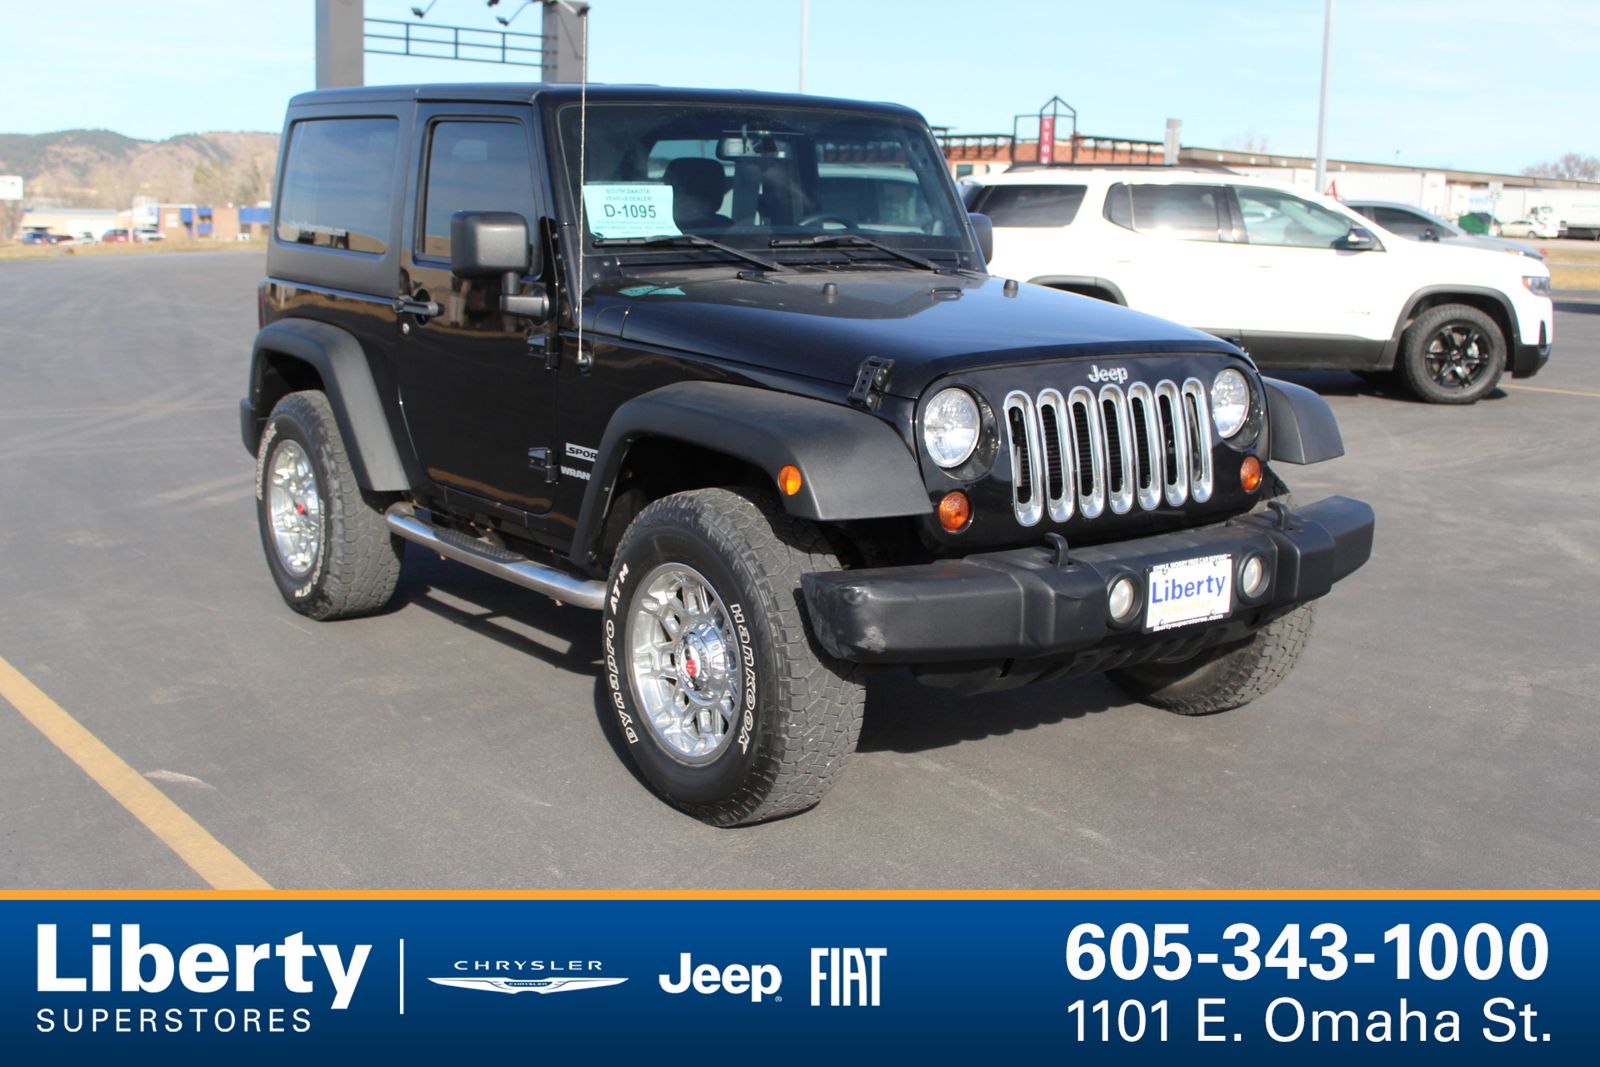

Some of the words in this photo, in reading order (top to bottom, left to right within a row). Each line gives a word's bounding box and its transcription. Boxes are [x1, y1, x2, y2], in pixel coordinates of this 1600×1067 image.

[604, 204, 656, 218] D-1095
[1088, 364, 1129, 384] Jeep
[1152, 574, 1226, 604] Liberty
